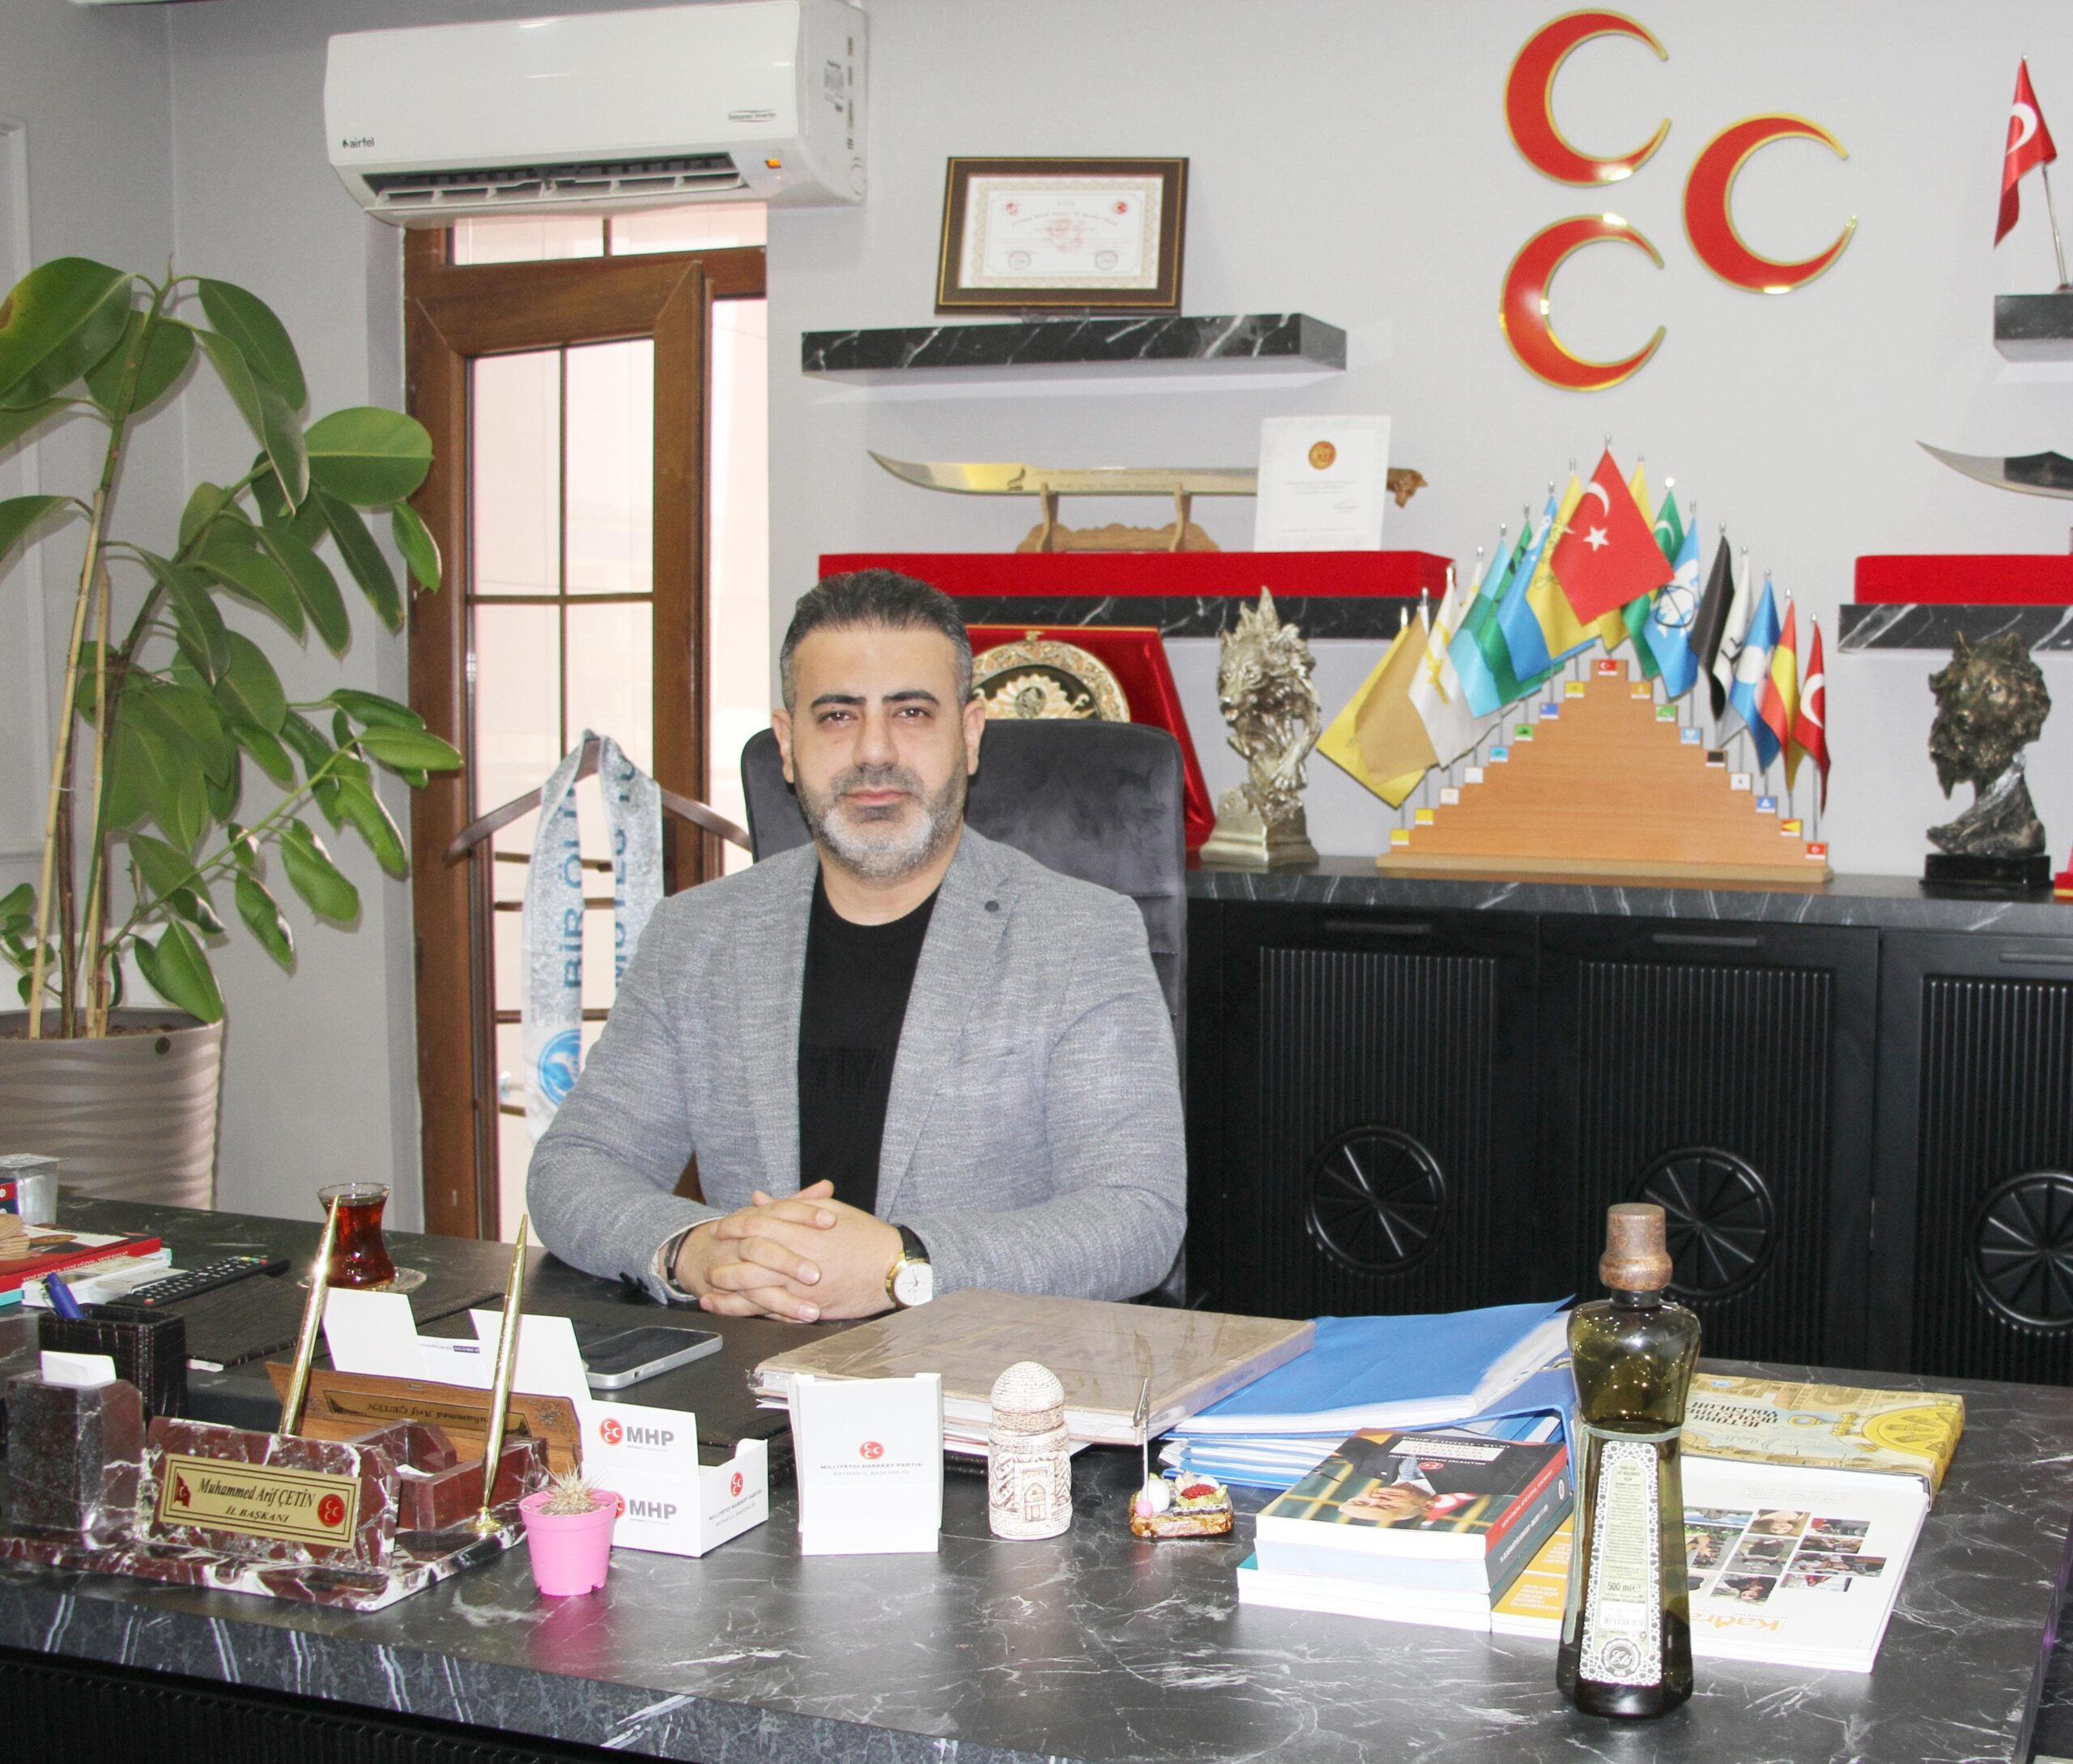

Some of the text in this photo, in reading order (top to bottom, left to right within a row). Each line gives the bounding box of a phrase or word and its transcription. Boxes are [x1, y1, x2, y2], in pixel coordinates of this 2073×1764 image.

[350, 137, 375, 149] airfel
[411, 1405, 433, 1418] Arif
[435, 1409, 487, 1424] uhammed
[627, 1425, 675, 1447] MHP
[198, 1477, 316, 1509] Muhammed Arif ÇETİN
[225, 1506, 290, 1523] İL BAŞKANI
[629, 1499, 678, 1520] MHP
[1607, 1581, 1621, 1592] 500
